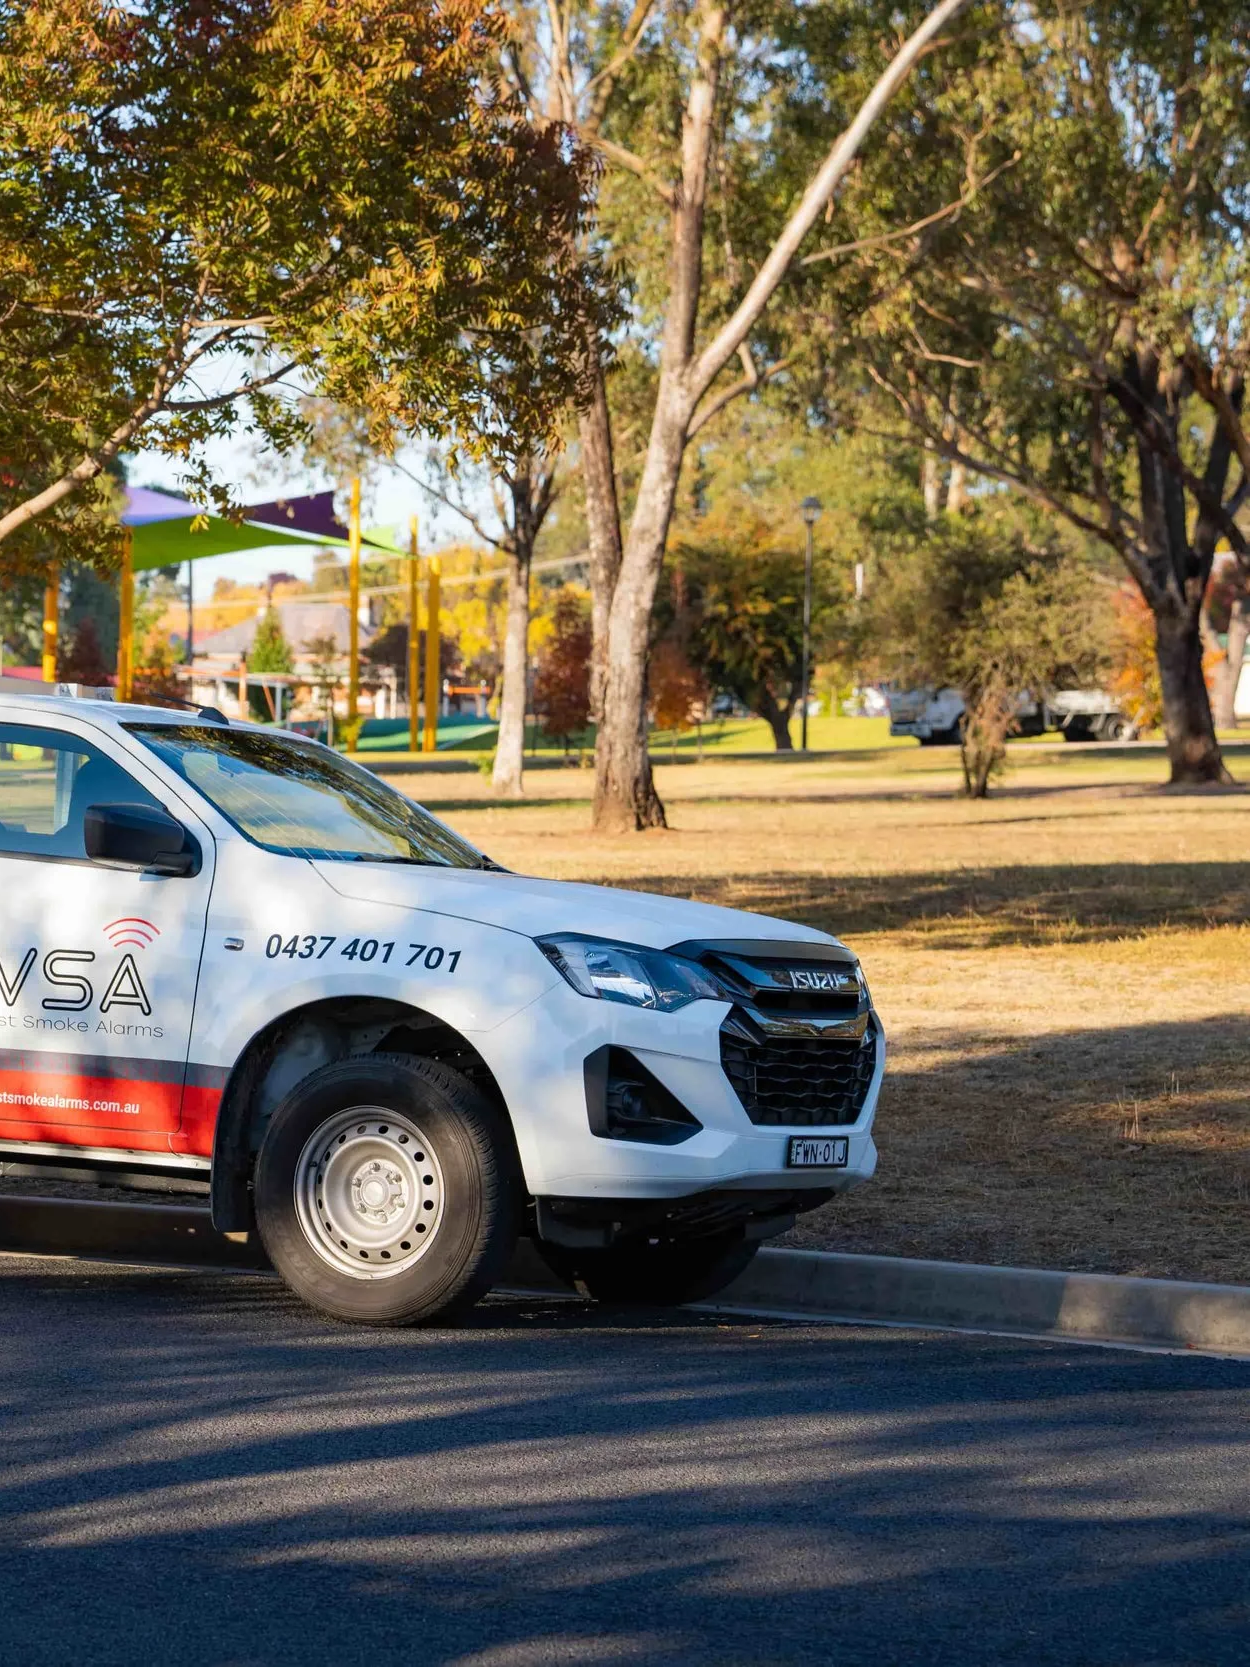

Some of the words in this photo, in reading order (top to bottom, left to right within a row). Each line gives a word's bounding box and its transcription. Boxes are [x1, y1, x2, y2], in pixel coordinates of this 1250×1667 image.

[265, 933, 336, 959] 0437
[340, 938, 395, 964] 401
[405, 943, 462, 973] 701
[790, 970, 840, 990] ISUZU
[22, 1014, 89, 1033] Smoke
[95, 1020, 164, 1038] Alarms
